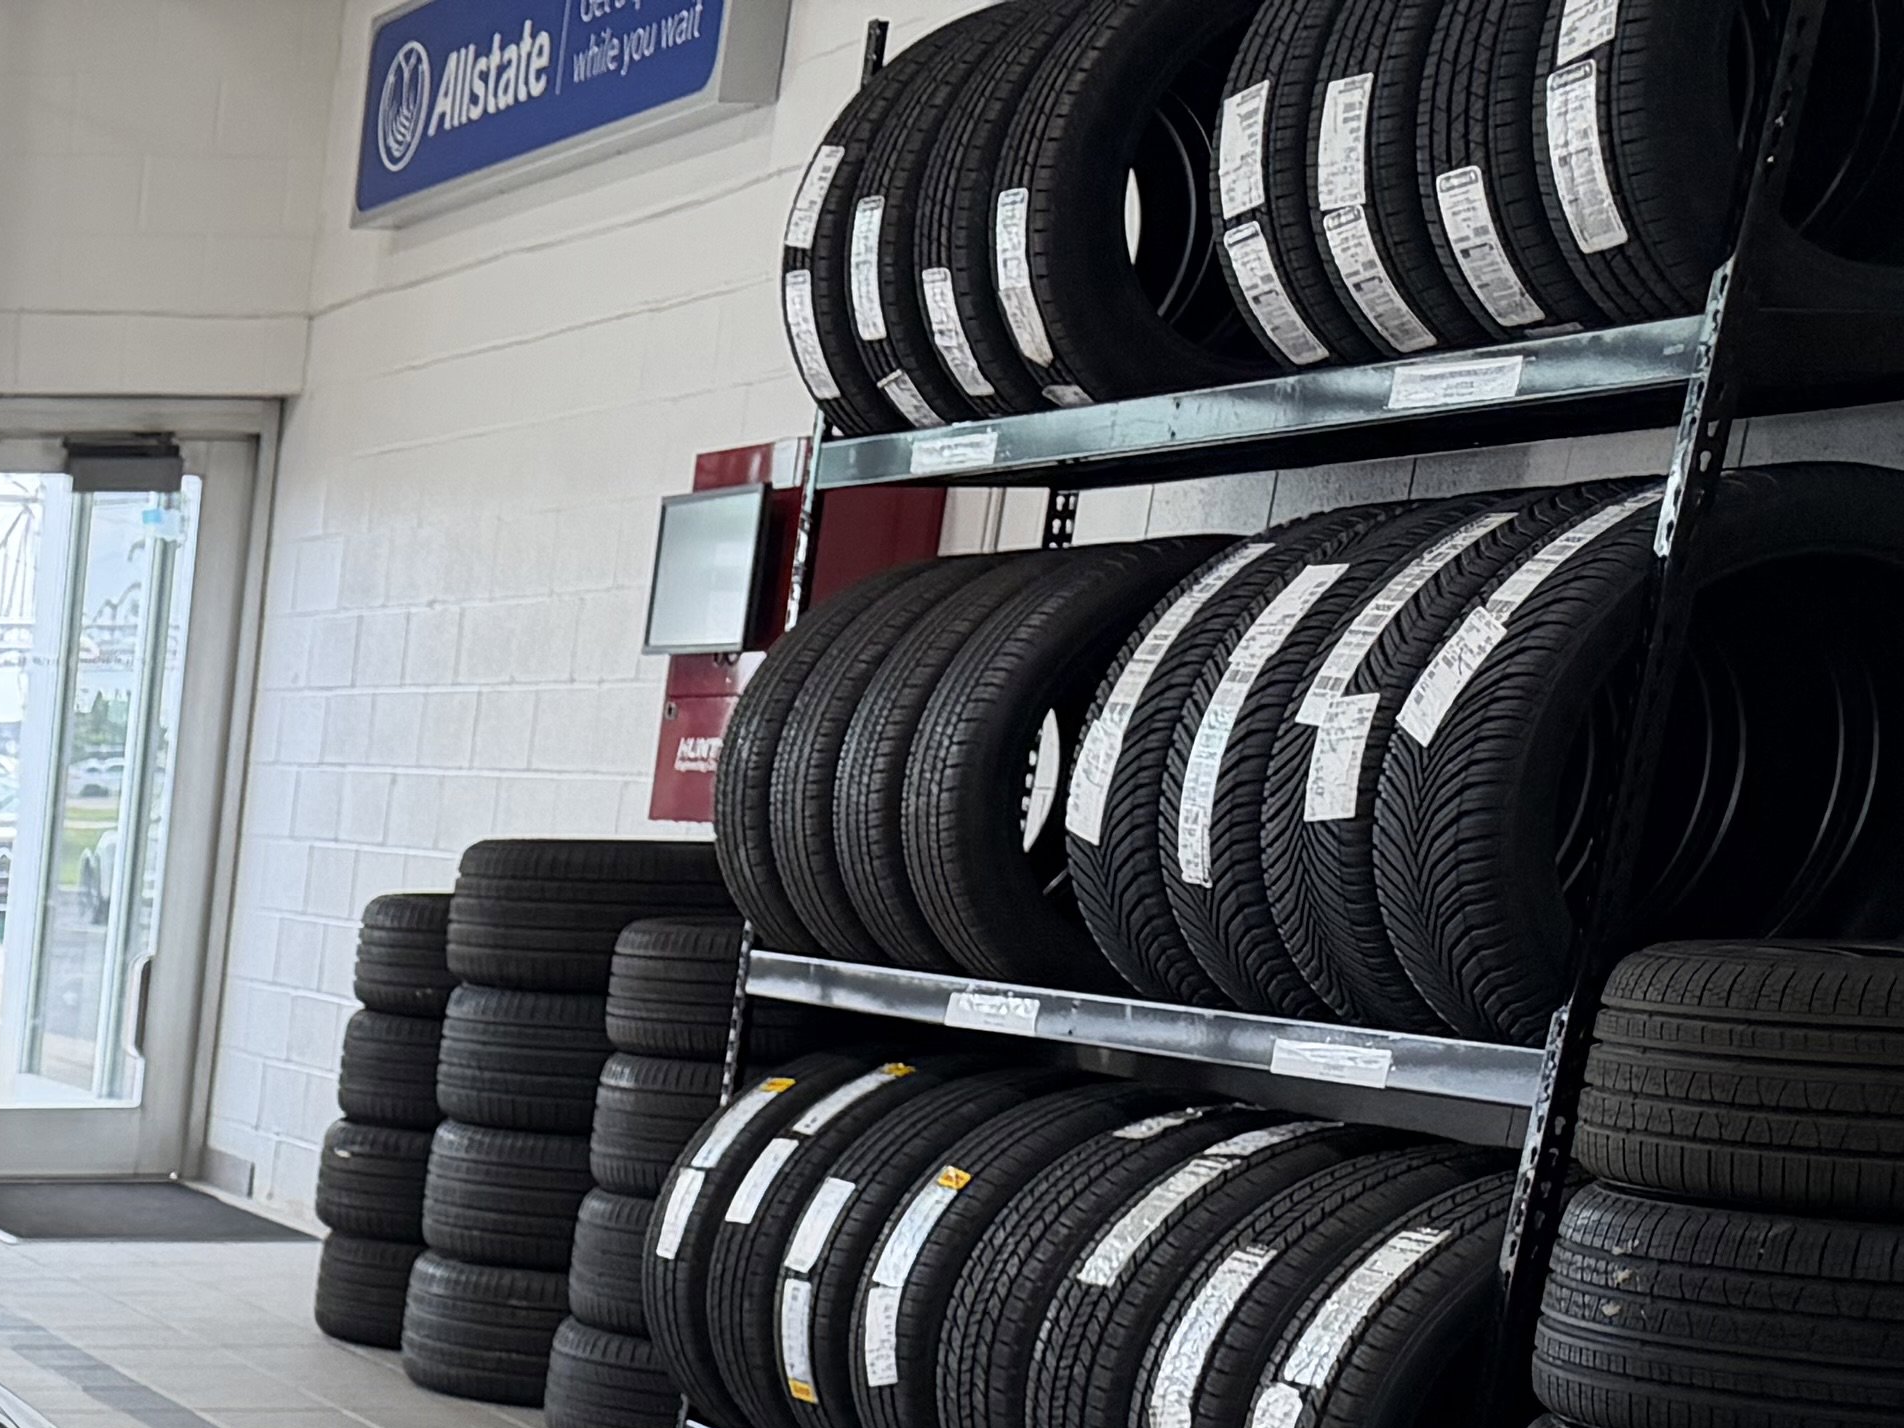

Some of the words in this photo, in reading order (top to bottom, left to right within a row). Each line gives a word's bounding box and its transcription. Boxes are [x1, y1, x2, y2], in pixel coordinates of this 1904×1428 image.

[427, 20, 550, 137] Allstate
[573, 27, 620, 83] while
[620, 22, 657, 76] you
[661, 0, 703, 48] wait
